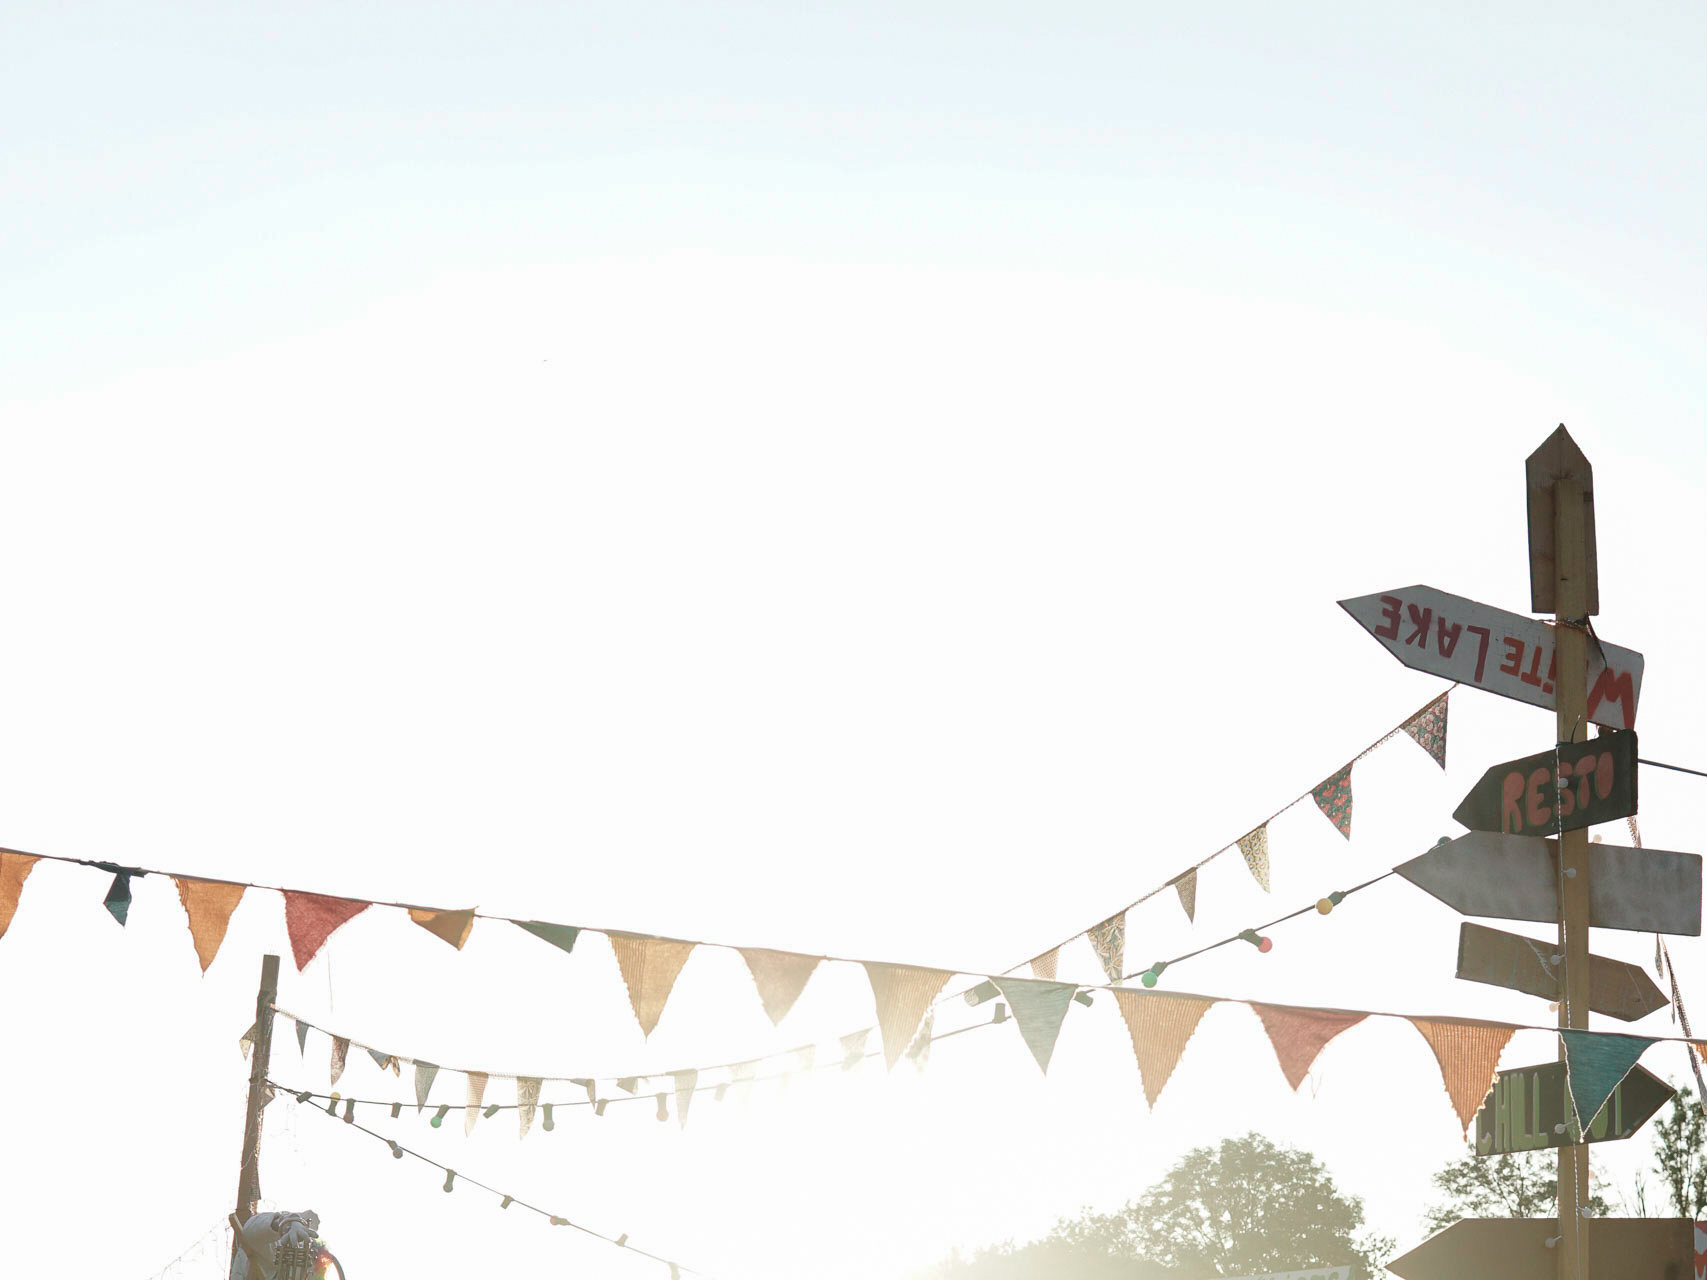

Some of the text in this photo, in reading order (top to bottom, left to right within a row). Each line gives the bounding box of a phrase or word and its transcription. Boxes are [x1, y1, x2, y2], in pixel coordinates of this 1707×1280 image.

[1374, 595, 1635, 731] WiTE LAKE
[1503, 752, 1614, 834] RESTO
